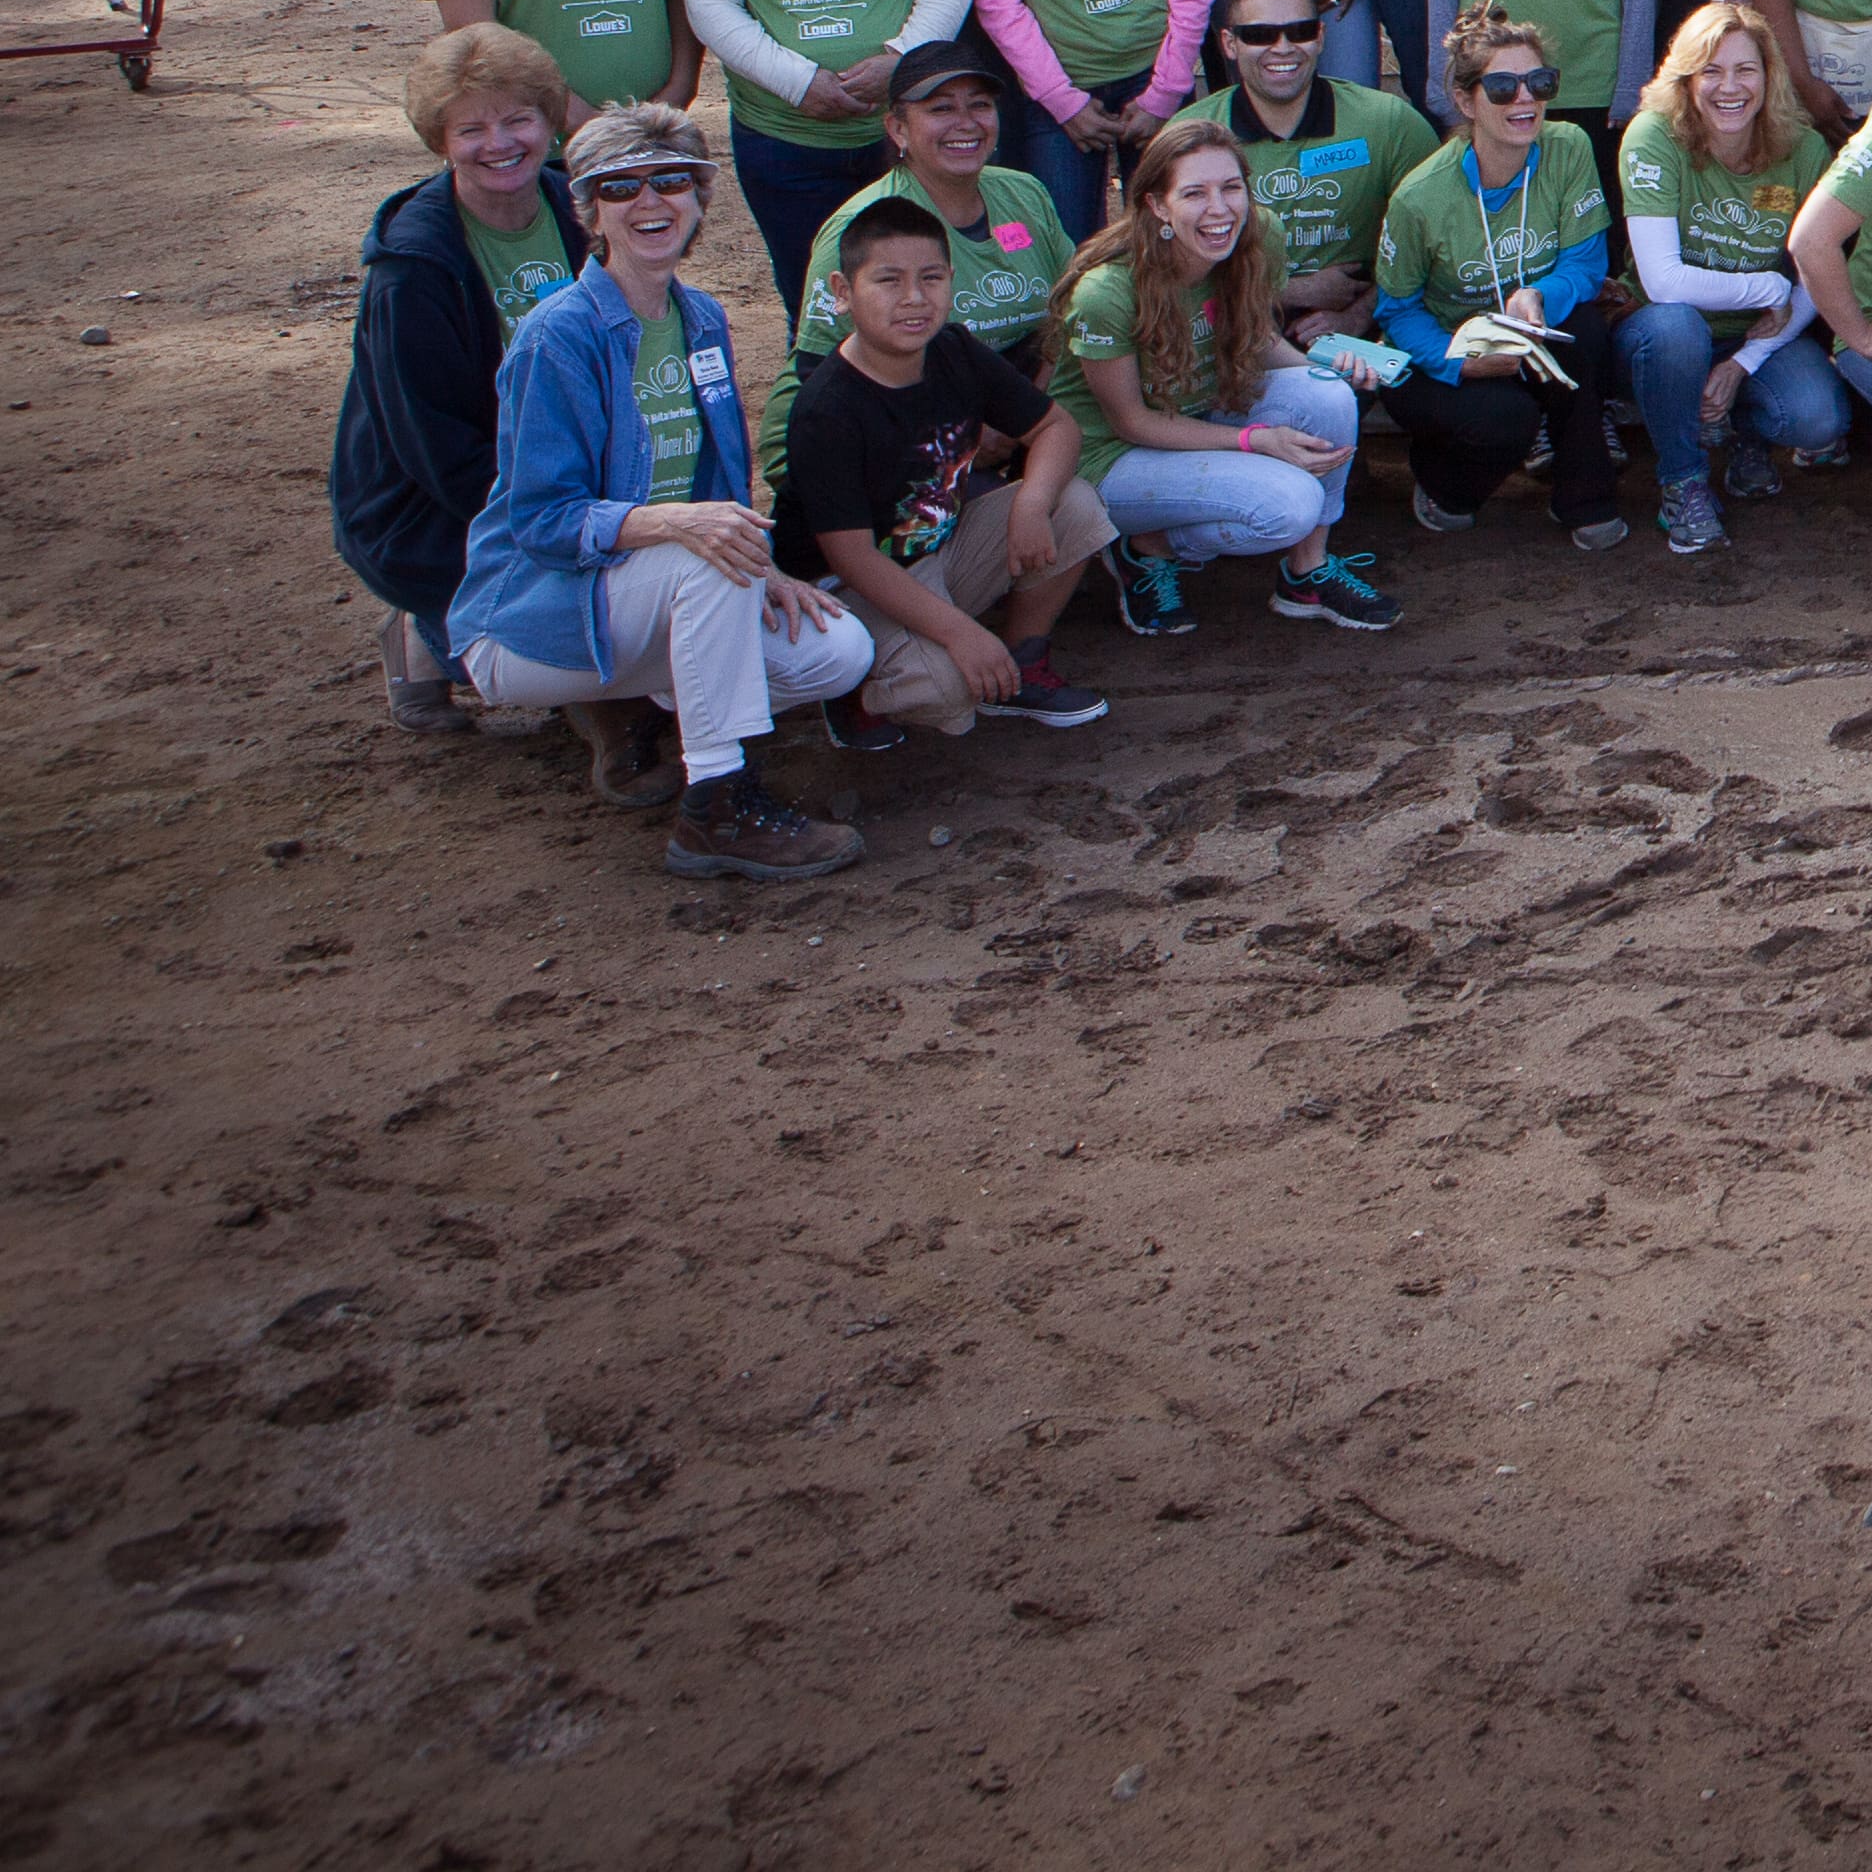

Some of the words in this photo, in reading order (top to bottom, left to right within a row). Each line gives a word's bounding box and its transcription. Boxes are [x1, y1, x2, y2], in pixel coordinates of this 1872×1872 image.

[1313, 148, 1357, 168] MARIO
[1272, 173, 1298, 195] 2016
[1295, 224, 1322, 247] Build
[1323, 221, 1351, 242] Week
[520, 266, 549, 286] 2016
[990, 276, 1015, 297] 2016
